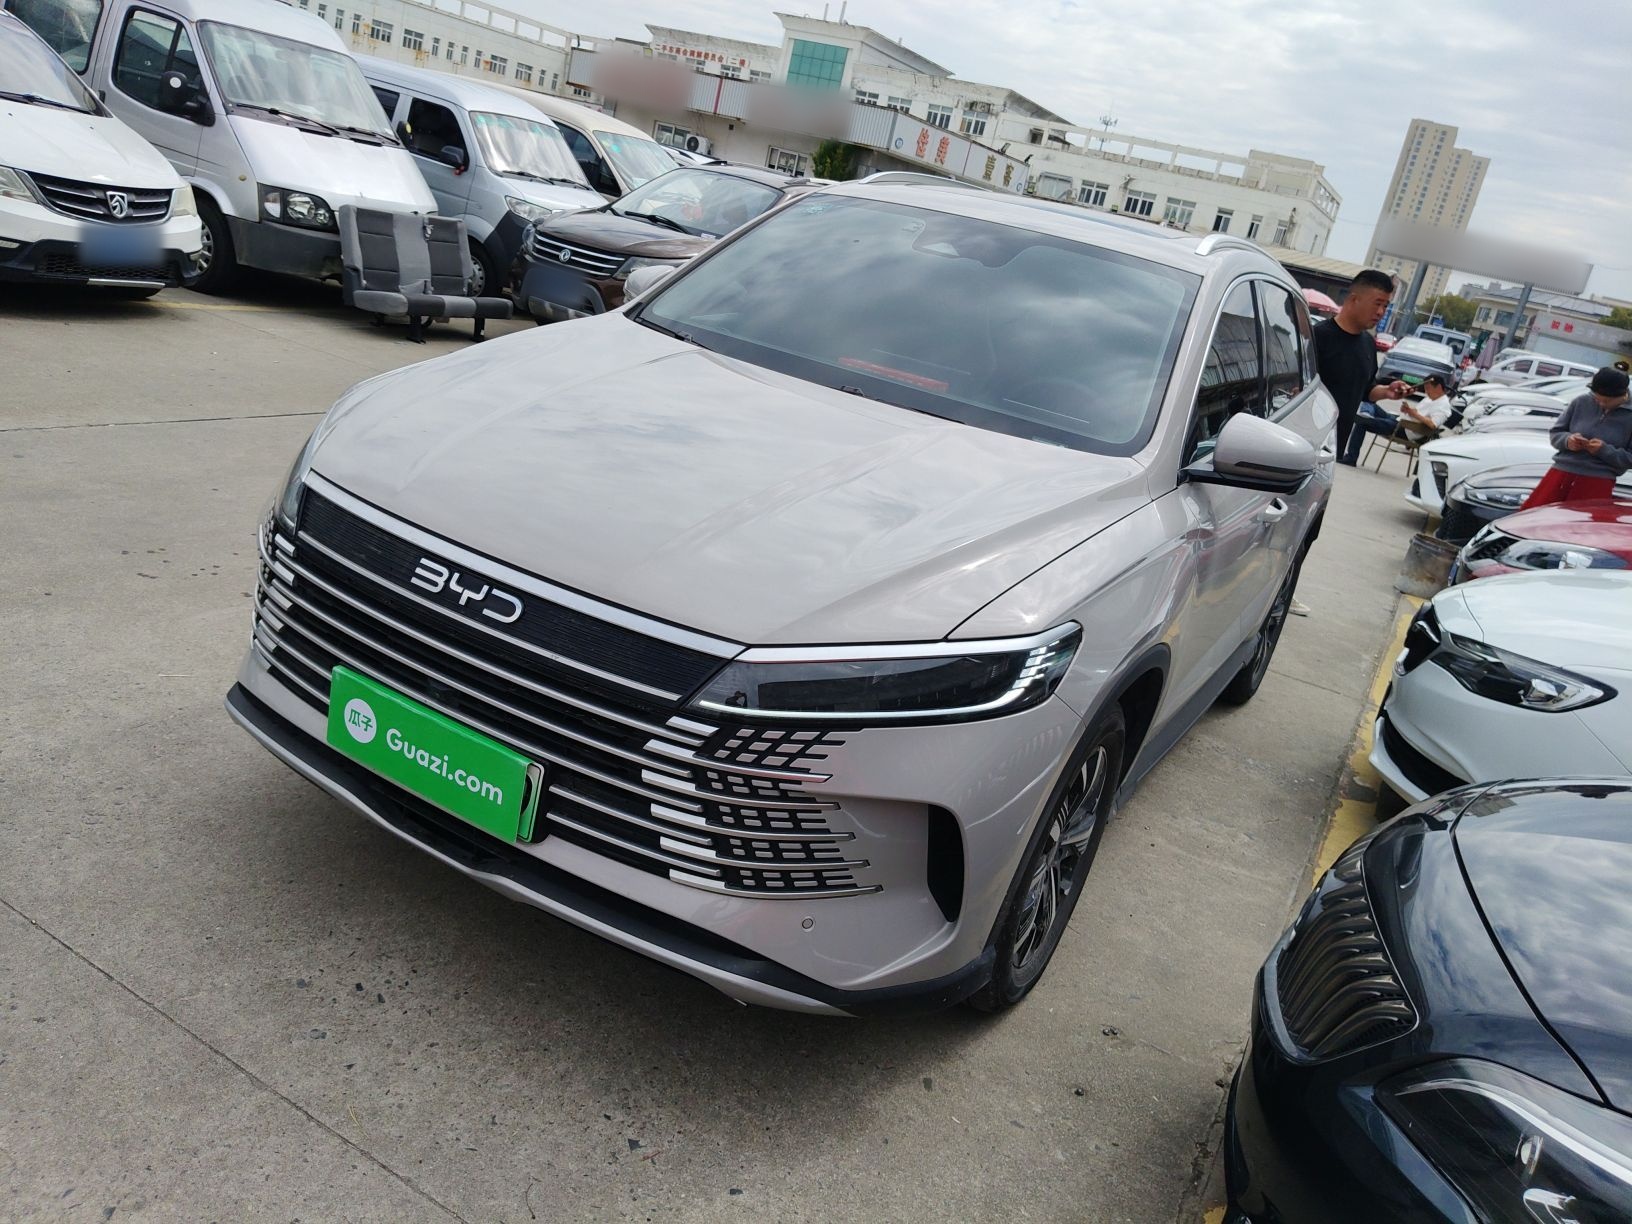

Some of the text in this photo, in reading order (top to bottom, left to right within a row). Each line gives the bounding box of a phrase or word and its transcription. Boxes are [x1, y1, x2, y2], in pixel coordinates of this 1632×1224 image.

[410, 557, 523, 624] BYD
[347, 707, 374, 733] 瓜子
[385, 727, 505, 806] Guazi.com
